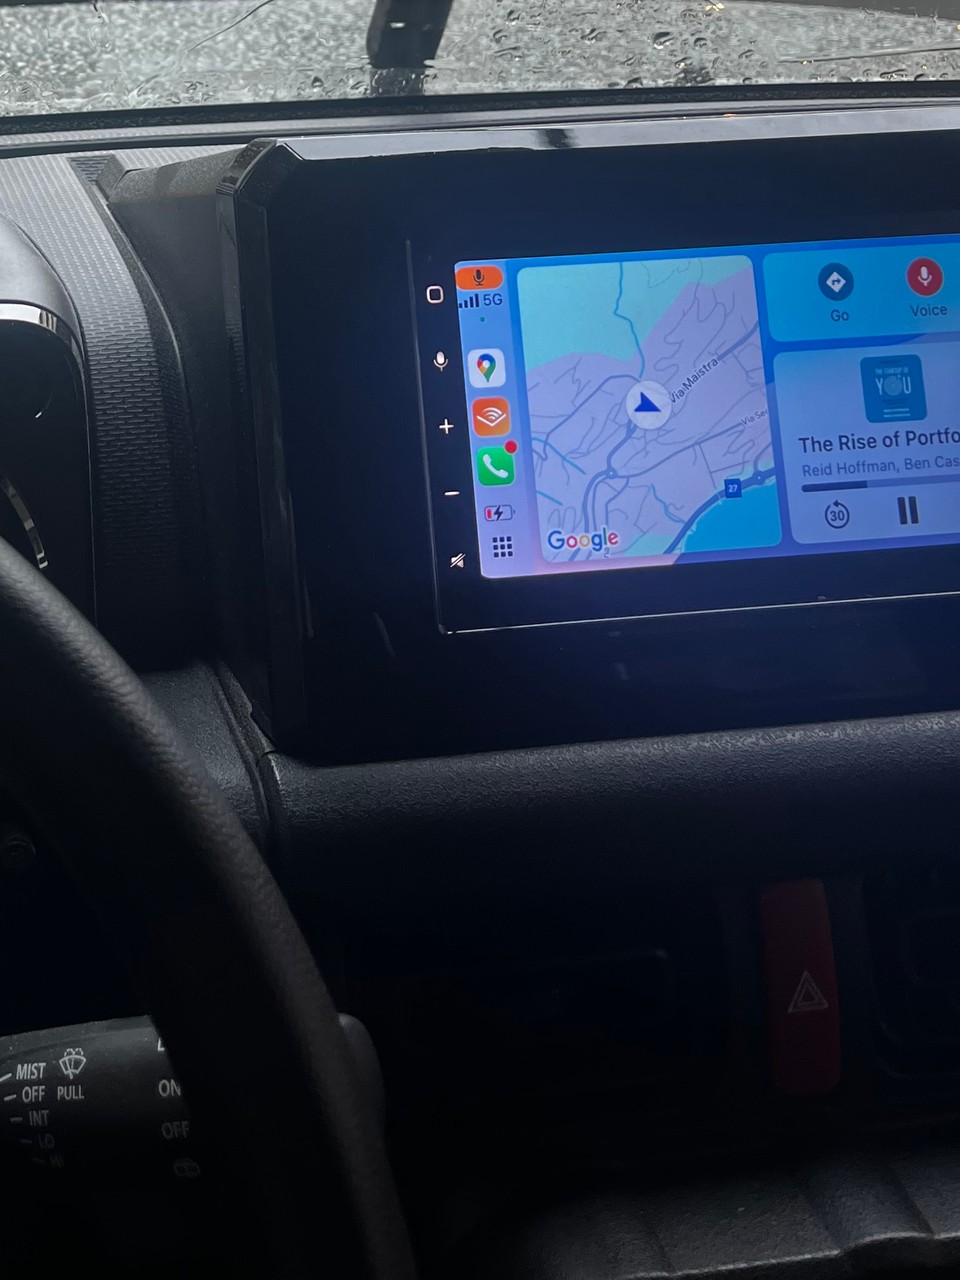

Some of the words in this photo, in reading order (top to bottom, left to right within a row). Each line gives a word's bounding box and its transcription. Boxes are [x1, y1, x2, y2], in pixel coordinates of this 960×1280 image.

[483, 293, 503, 306] 5G
[831, 309, 849, 322] Go
[910, 304, 948, 317] Voice
[670, 388, 685, 403] Via
[683, 358, 719, 391] Maistra
[741, 415, 755, 426] Via
[798, 436, 833, 453] The
[838, 433, 877, 451] Rise
[882, 430, 900, 448] of
[905, 427, 960, 446] Portfo
[802, 463, 832, 477] Reid
[837, 460, 900, 474] Hoffman,
[904, 458, 930, 470] Ben
[934, 455, 960, 468] Cas
[728, 484, 738, 493] 27
[830, 510, 845, 522] 30
[548, 527, 618, 551] Google
[16, 1062, 46, 1080] MIST
[21, 1085, 46, 1103] OFF
[57, 1085, 85, 1101] PULL
[158, 1079, 181, 1097] ON
[28, 1109, 49, 1127] INT
[161, 1120, 190, 1140] OFF
